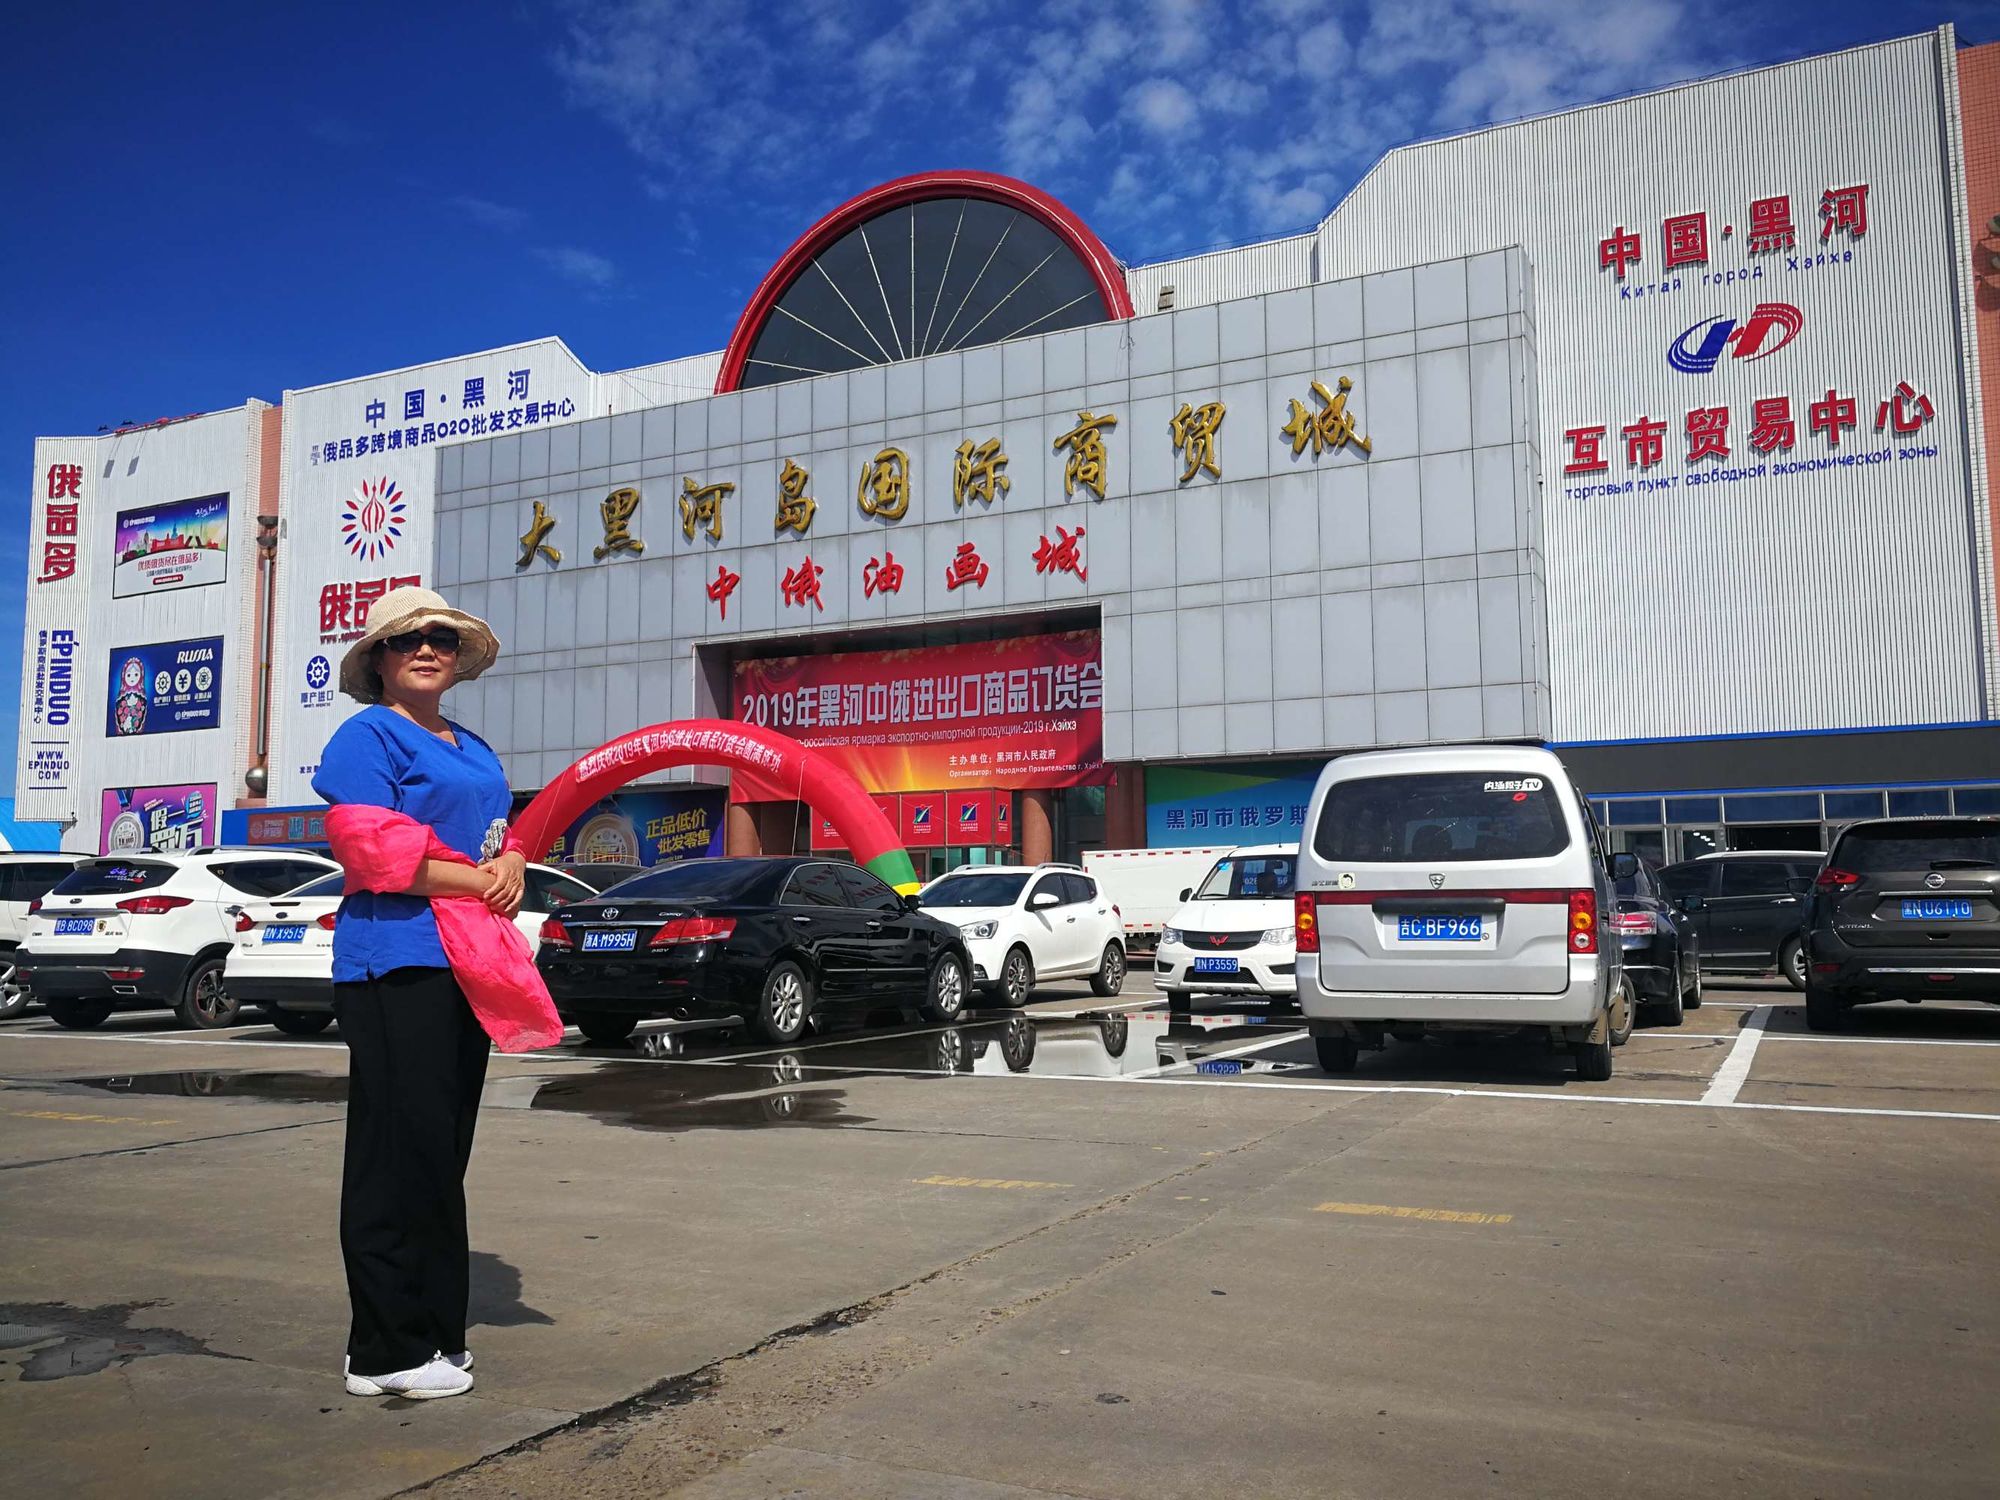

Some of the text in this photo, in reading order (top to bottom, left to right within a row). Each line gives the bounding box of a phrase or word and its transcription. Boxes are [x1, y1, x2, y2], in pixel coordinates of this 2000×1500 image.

[1600, 183, 1870, 280] 中国·黑河
[1621, 278, 1682, 299] Китай
[1702, 265, 1763, 287] город
[365, 369, 531, 429] 中国·黑河
[1563, 380, 1936, 474] 互市贸易中心
[514, 375, 1374, 569] 大黑河岛国际商贸城
[1565, 477, 1634, 500] торговый
[1638, 474, 1679, 493] пункт
[1685, 463, 1767, 487] свободной
[705, 525, 1087, 621] 中俄油画城
[28, 760, 70, 770] EPINDUO
[996, 748, 1057, 763] 黑河市人民政府
[38, 771, 60, 780] COM
[646, 807, 708, 840] 正品低价
[658, 829, 711, 855] 批发零售
[1401, 918, 1480, 936] 吉C·BF966
